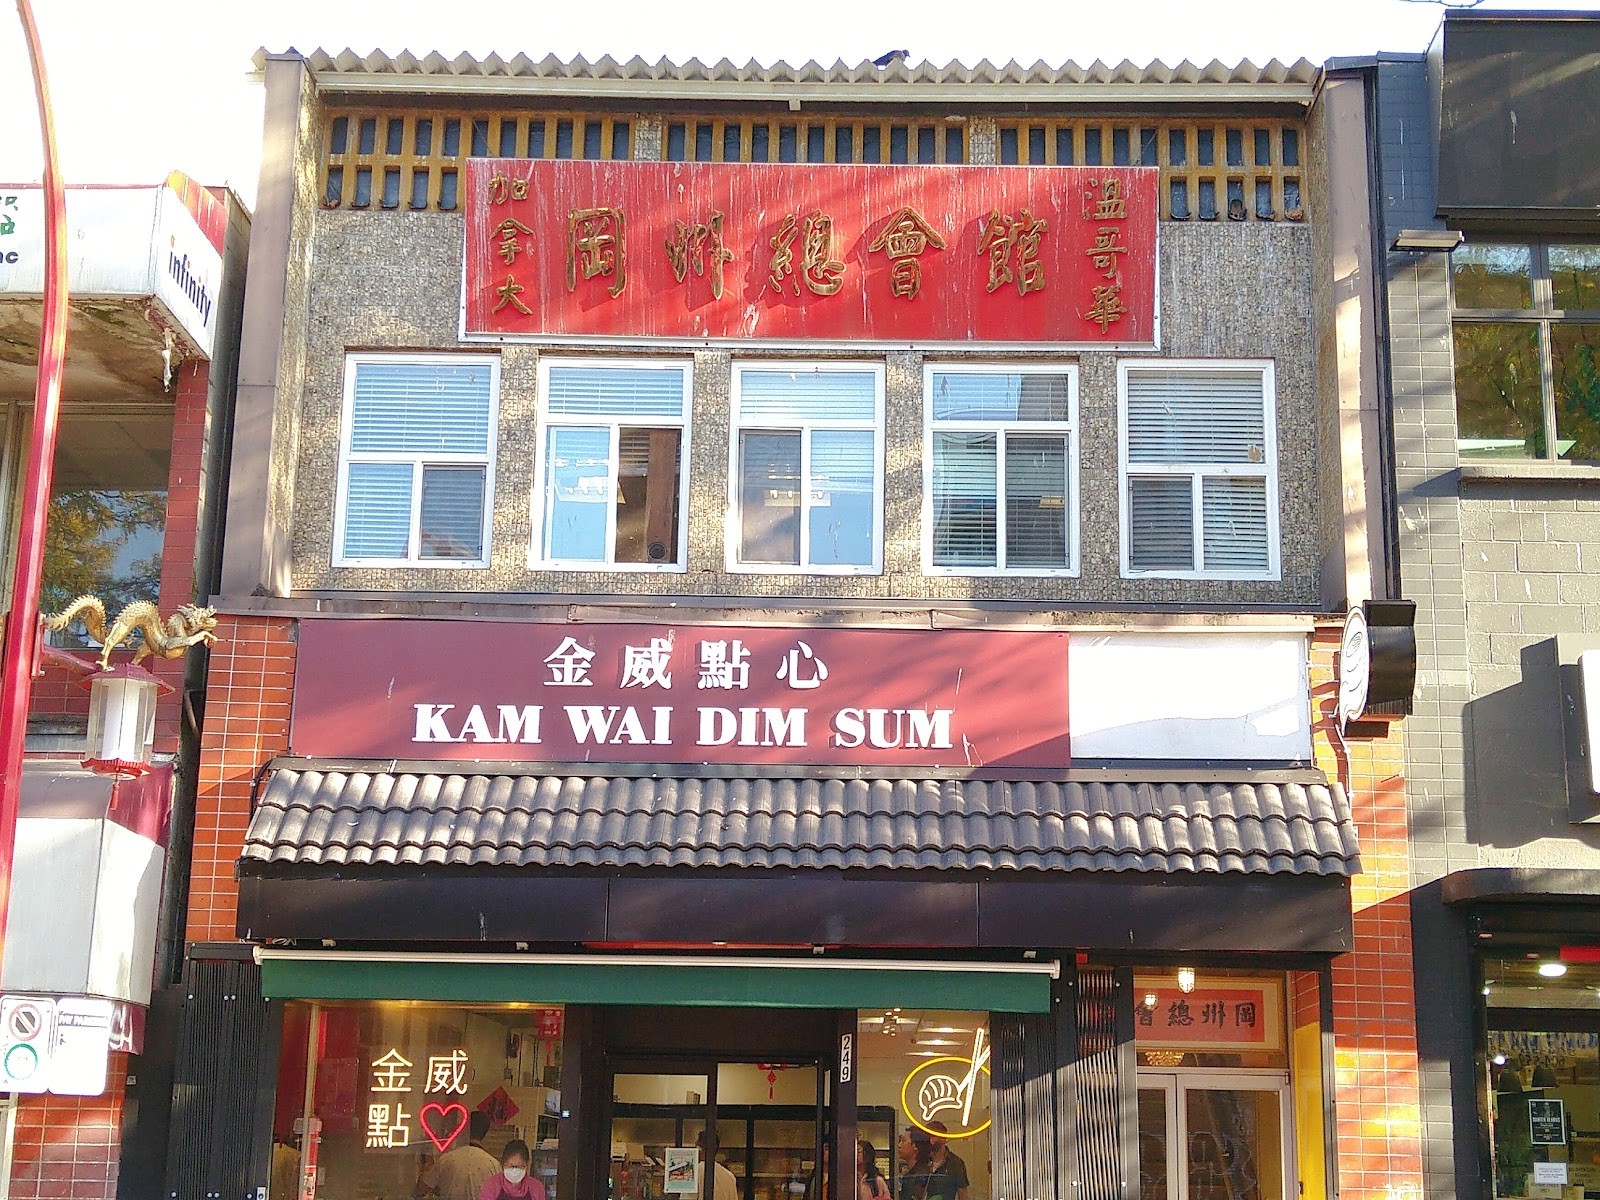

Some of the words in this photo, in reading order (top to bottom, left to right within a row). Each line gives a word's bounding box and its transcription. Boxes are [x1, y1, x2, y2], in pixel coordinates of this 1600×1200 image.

[488, 170, 534, 315] 加拿大
[168, 234, 211, 328] infinity
[543, 636, 829, 690] 金威點心
[411, 703, 542, 743] KAM
[563, 705, 674, 745] WAI
[695, 706, 808, 748] DIM
[833, 708, 955, 749] SUM
[370, 1048, 469, 1095] 金威
[841, 1035, 851, 1081] 249
[365, 1102, 412, 1149] 點
